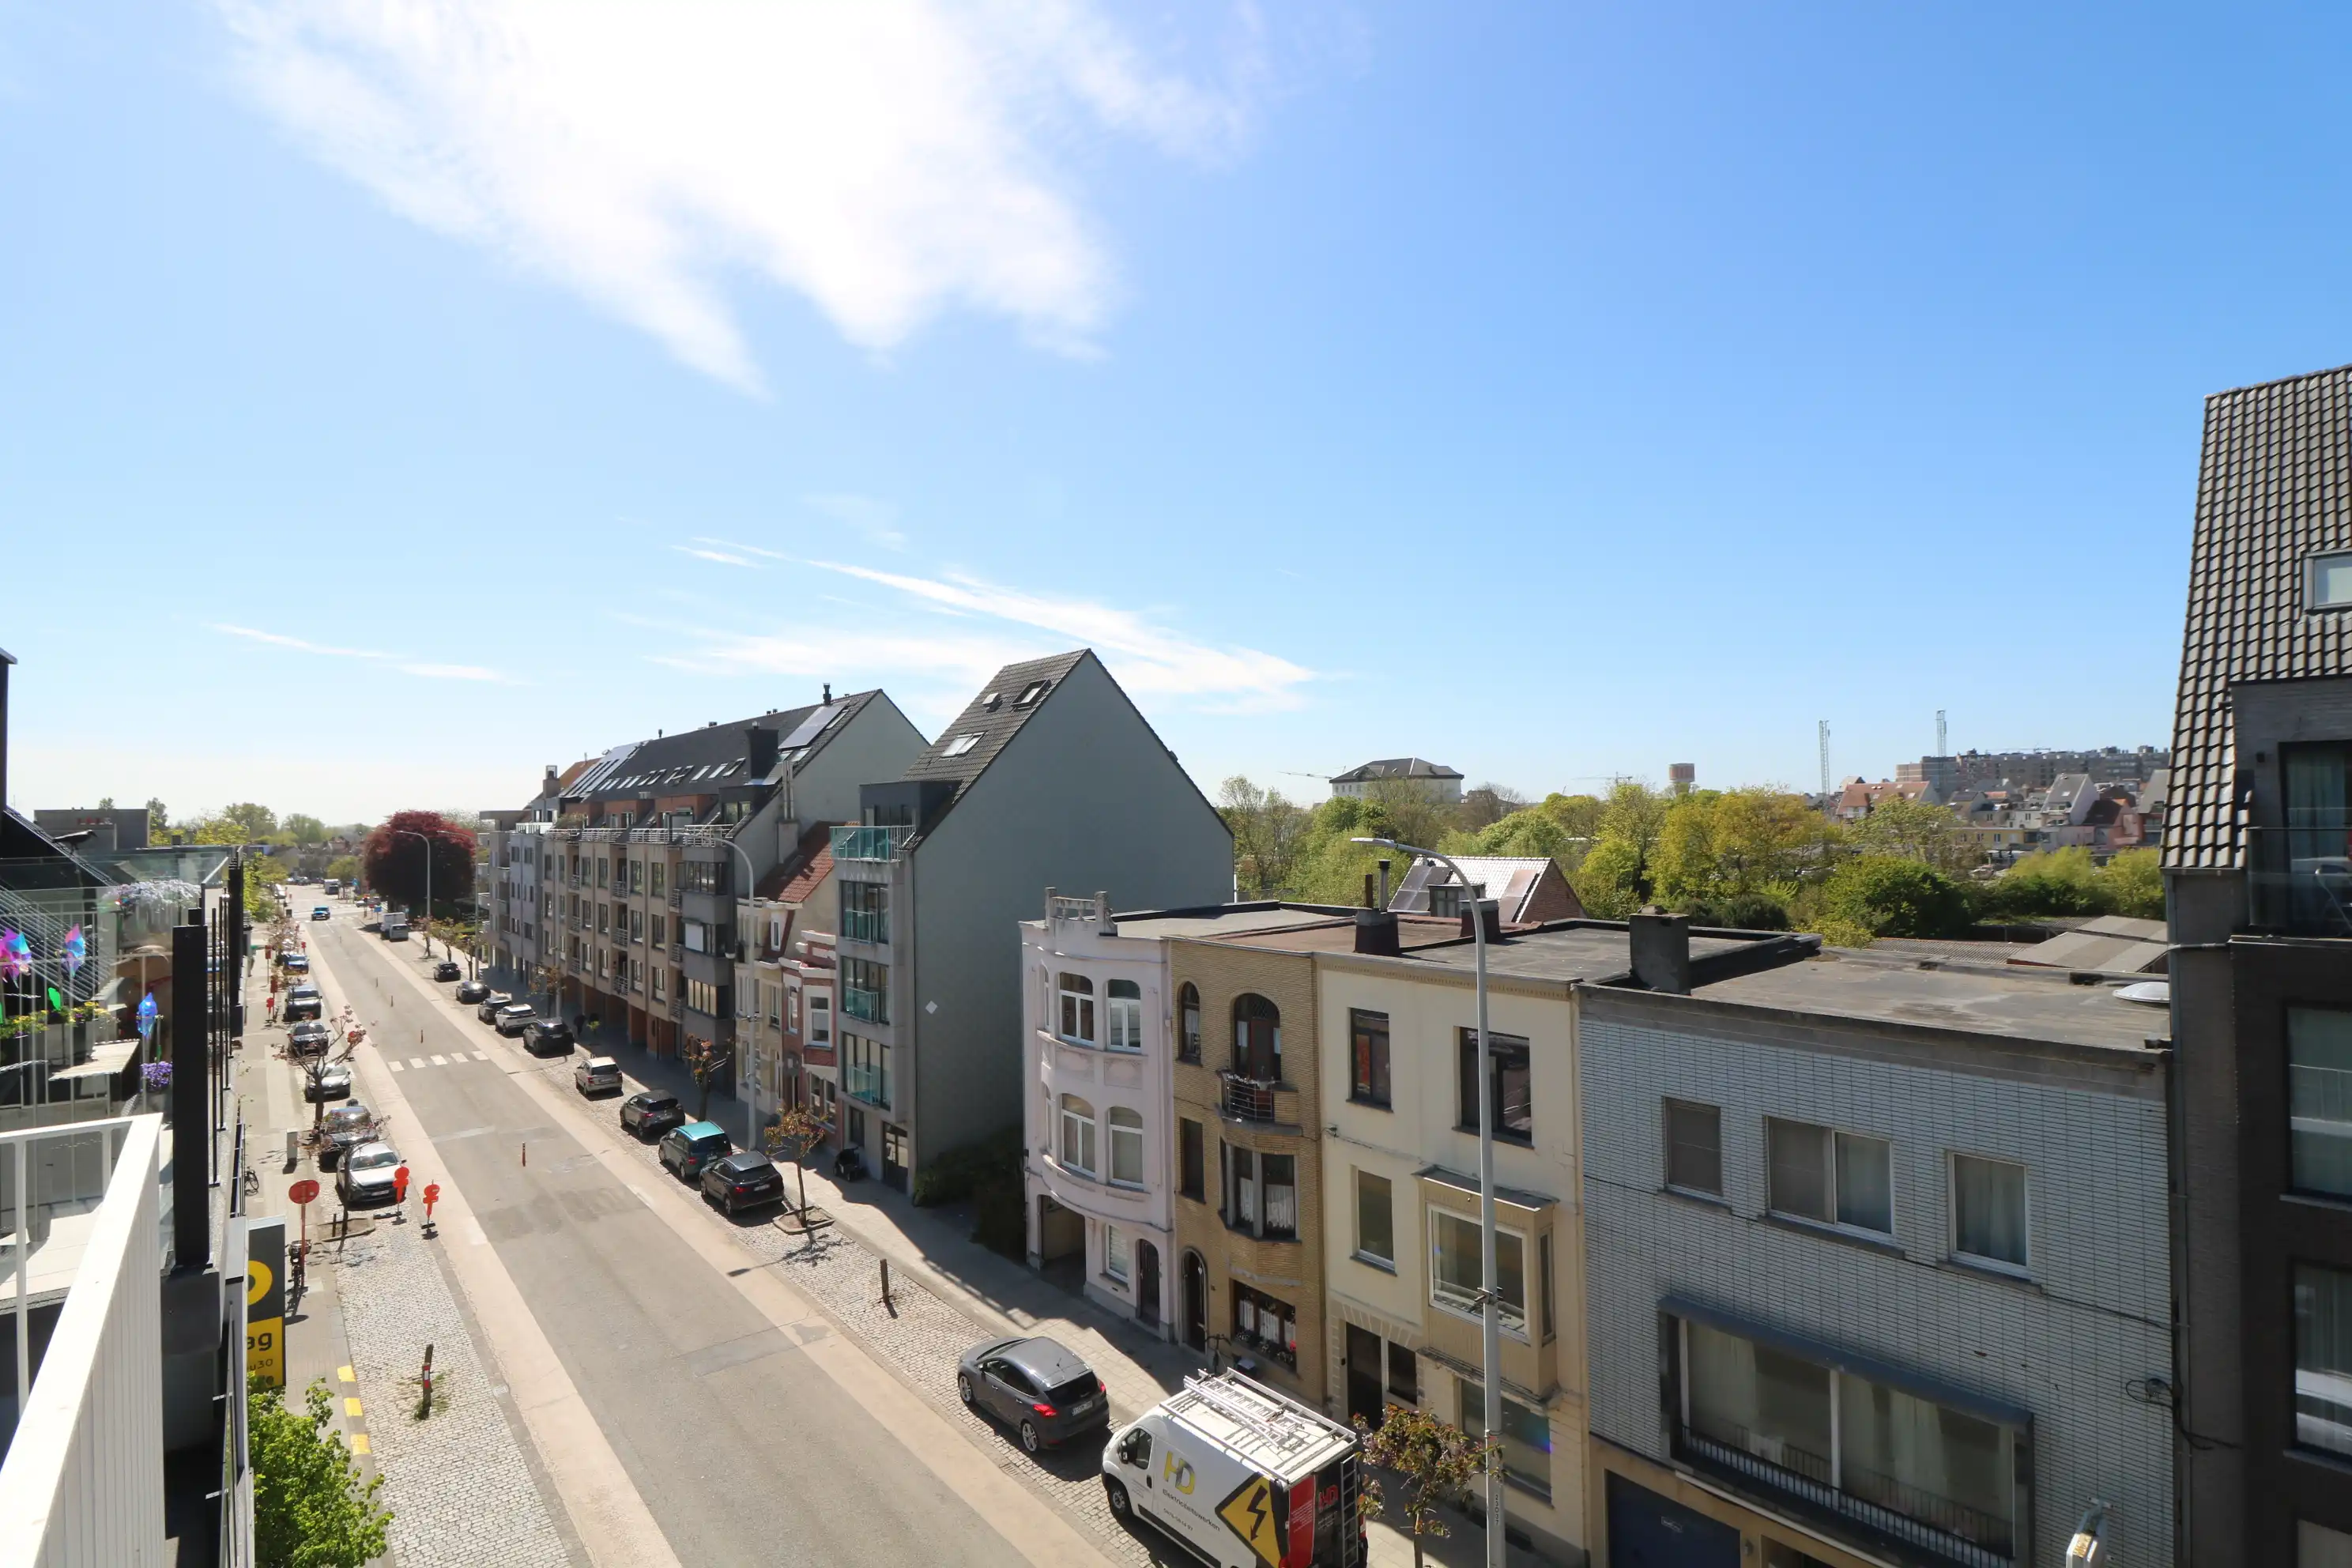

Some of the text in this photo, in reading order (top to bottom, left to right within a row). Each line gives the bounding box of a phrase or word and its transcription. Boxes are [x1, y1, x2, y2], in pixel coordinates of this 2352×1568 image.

[1164, 1450, 1195, 1495] HD
[1163, 1488, 1220, 1532] Elektriciteitswerken
[1318, 1484, 1339, 1513] HD
